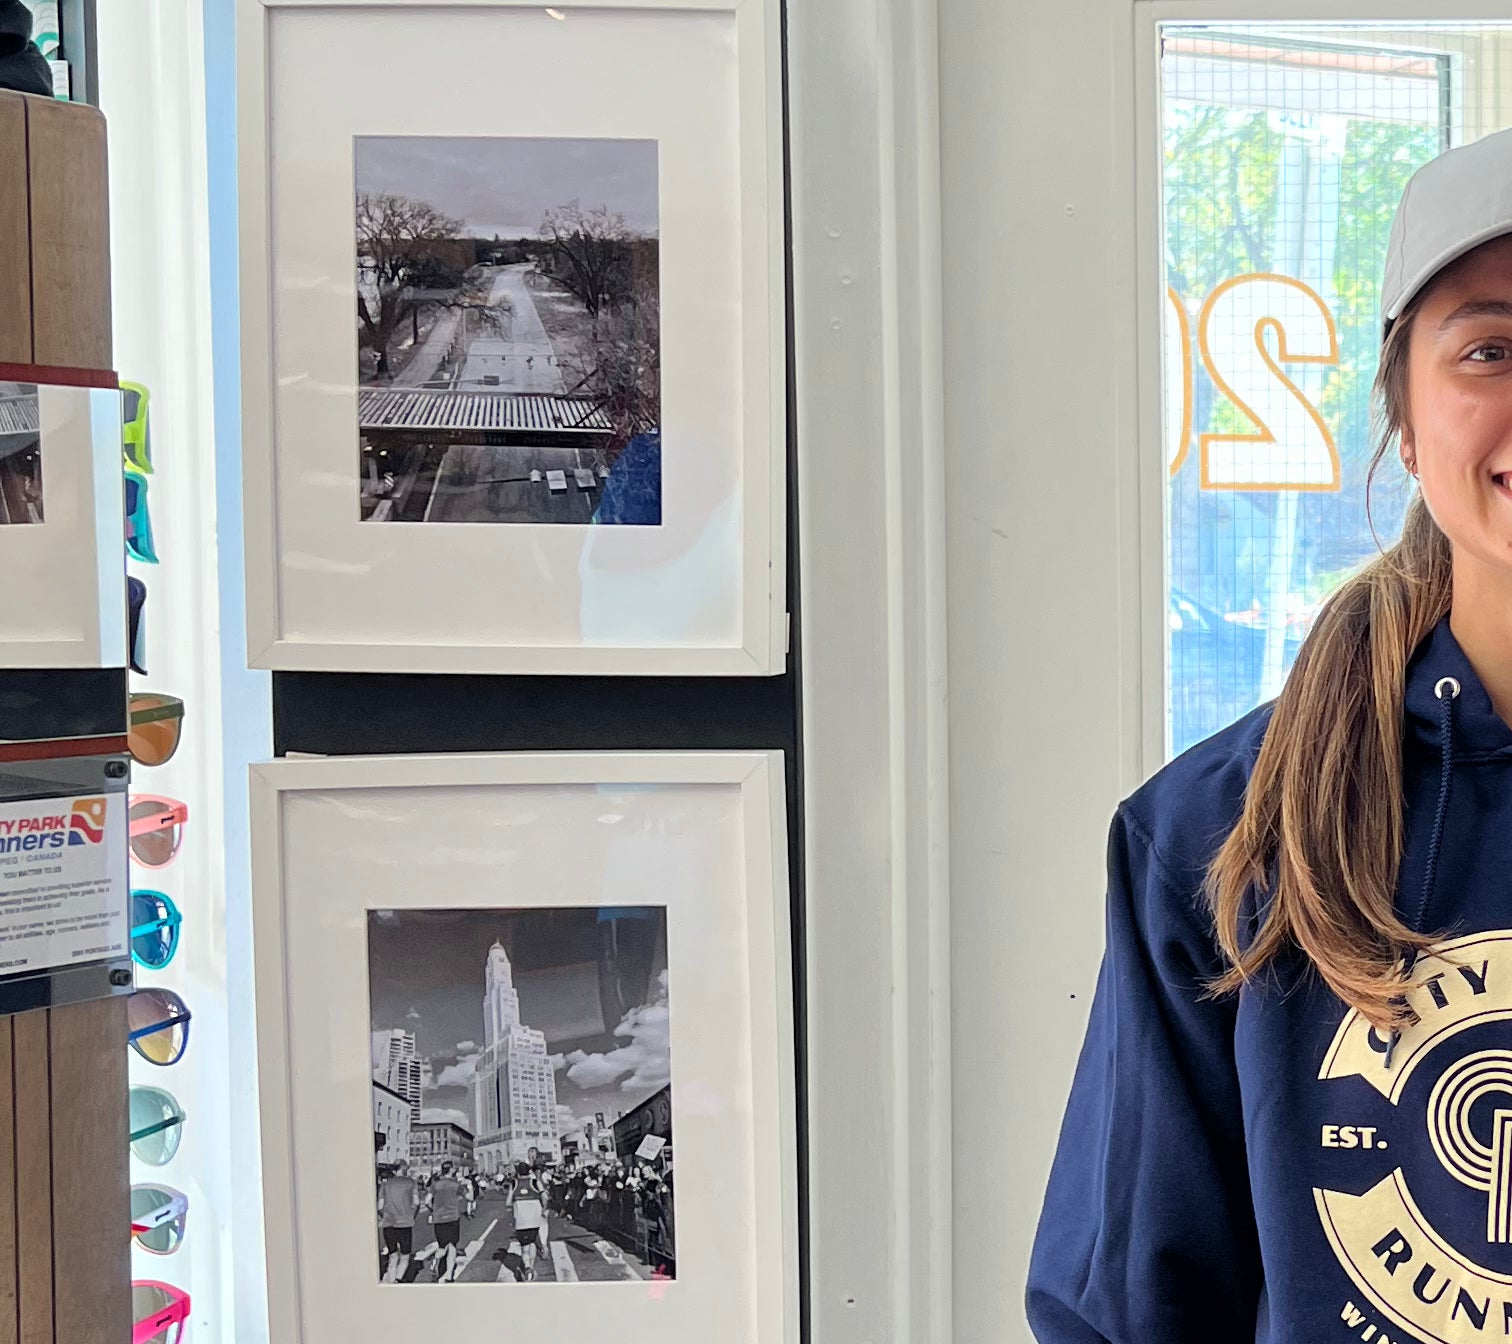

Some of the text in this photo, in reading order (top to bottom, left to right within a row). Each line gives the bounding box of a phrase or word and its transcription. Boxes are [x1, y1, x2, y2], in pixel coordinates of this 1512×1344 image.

[18, 815, 67, 833] PARK
[27, 852, 62, 863] CANADA
[1321, 1125, 1388, 1149] EST.
